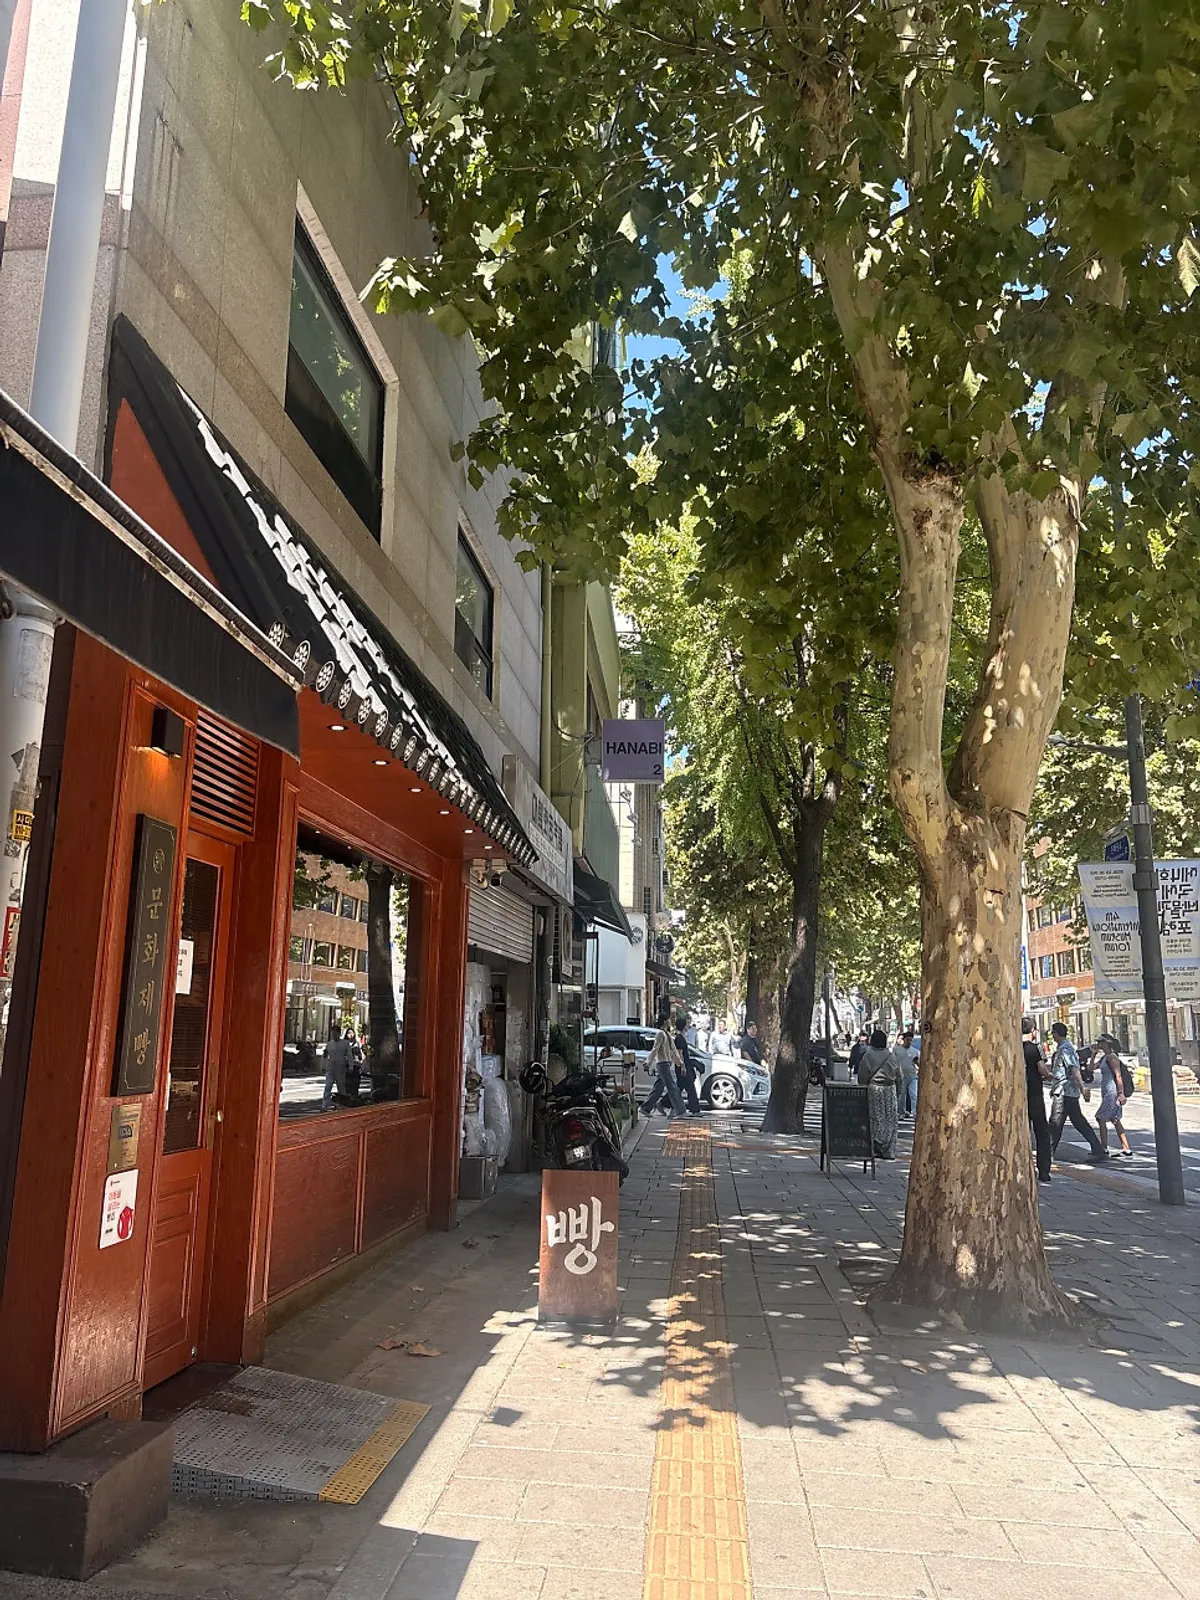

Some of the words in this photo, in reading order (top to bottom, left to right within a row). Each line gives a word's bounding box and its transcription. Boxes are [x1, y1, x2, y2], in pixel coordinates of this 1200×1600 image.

[606, 741, 662, 755] HANABI
[653, 764, 662, 775] 2
[545, 1196, 615, 1275] 빵
